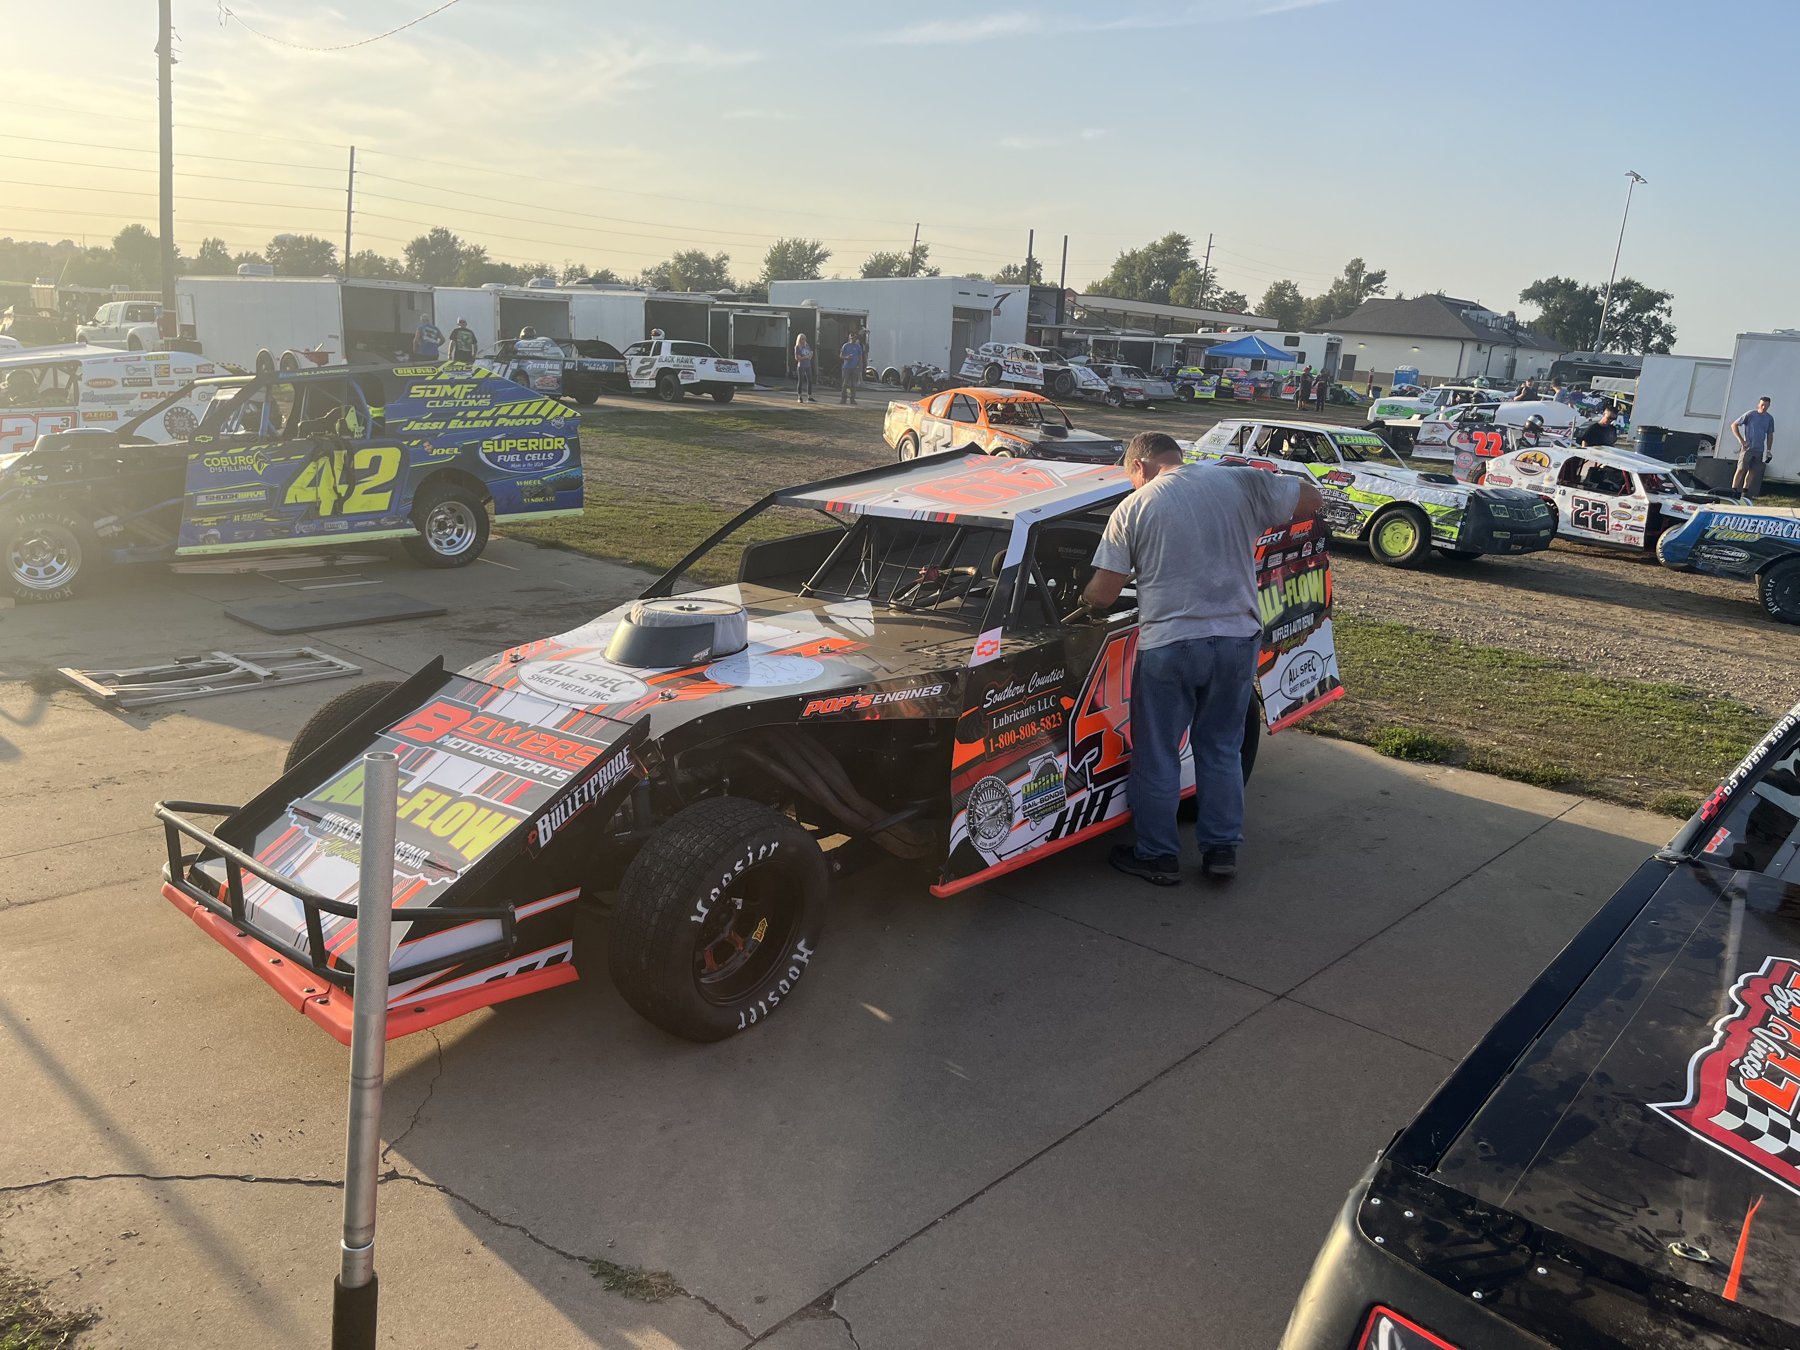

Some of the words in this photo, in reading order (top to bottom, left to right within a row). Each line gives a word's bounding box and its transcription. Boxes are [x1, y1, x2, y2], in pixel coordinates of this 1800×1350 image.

[635, 357, 656, 378] 2
[657, 356, 676, 364] BLACK
[677, 356, 695, 364] HAWK
[1004, 360, 1023, 375] 75
[409, 384, 477, 399] SDMF
[426, 399, 491, 408] CUSTOMS
[60, 417, 70, 428] 3
[85, 411, 113, 419] AERO
[402, 419, 446, 431] JESSI
[448, 418, 492, 429] ELLEN
[494, 417, 543, 427] PHOTO
[430, 447, 461, 456] JOEL
[481, 437, 566, 453] SUPERIOR
[1337, 434, 1381, 447] LEHMAN
[1473, 431, 1504, 457] 22
[203, 455, 253, 468] COBURG
[209, 464, 252, 473] DISTILLING
[497, 454, 521, 463] FUEL
[524, 452, 554, 462] CELLS
[284, 446, 402, 517] 42
[1574, 497, 1608, 533] 22
[1705, 512, 1800, 539] LOUDERBACK
[1256, 530, 1287, 547] GRT
[1704, 526, 1765, 543] Farms
[1765, 578, 1781, 614] Hoosier
[1272, 626, 1290, 643] MUFFLER
[538, 663, 578, 677] ALL
[578, 673, 636, 693] SPEC
[1288, 667, 1299, 686] ALL
[1300, 655, 1317, 675] SPEC
[528, 673, 560, 687] SHEET
[560, 681, 588, 696] METAL
[588, 690, 611, 701] INC.
[802, 693, 875, 716] POP'S
[872, 684, 943, 705] ENGINES
[983, 682, 1025, 708] Southern
[1027, 667, 1065, 694] Counties
[1289, 683, 1300, 695] SHEET
[1300, 678, 1310, 689] METAL
[992, 704, 1036, 729] Lubricants
[1037, 694, 1057, 714] LLC
[387, 701, 605, 767] BOWERS
[989, 711, 1063, 753] 1-800-808-5823
[1771, 715, 1796, 745] RACE
[436, 734, 573, 782] MOTORSPORTS
[1741, 745, 1769, 779] WRAP
[535, 743, 632, 848] BULLETPROOF
[590, 763, 635, 804] TEES
[977, 780, 993, 794] CROP
[993, 781, 1012, 815] DUSTERS
[1022, 771, 1064, 799] Ability
[1719, 779, 1739, 797] CO.
[311, 763, 522, 861] A-FLOW
[1021, 789, 1065, 812] BAIL-BONDS
[316, 812, 361, 844] MUFFLER
[394, 841, 431, 870] REPAIR
[690, 841, 780, 924] Hoosier
[737, 938, 815, 1030] Hoosier
[1739, 1026, 1789, 1079] Vince
